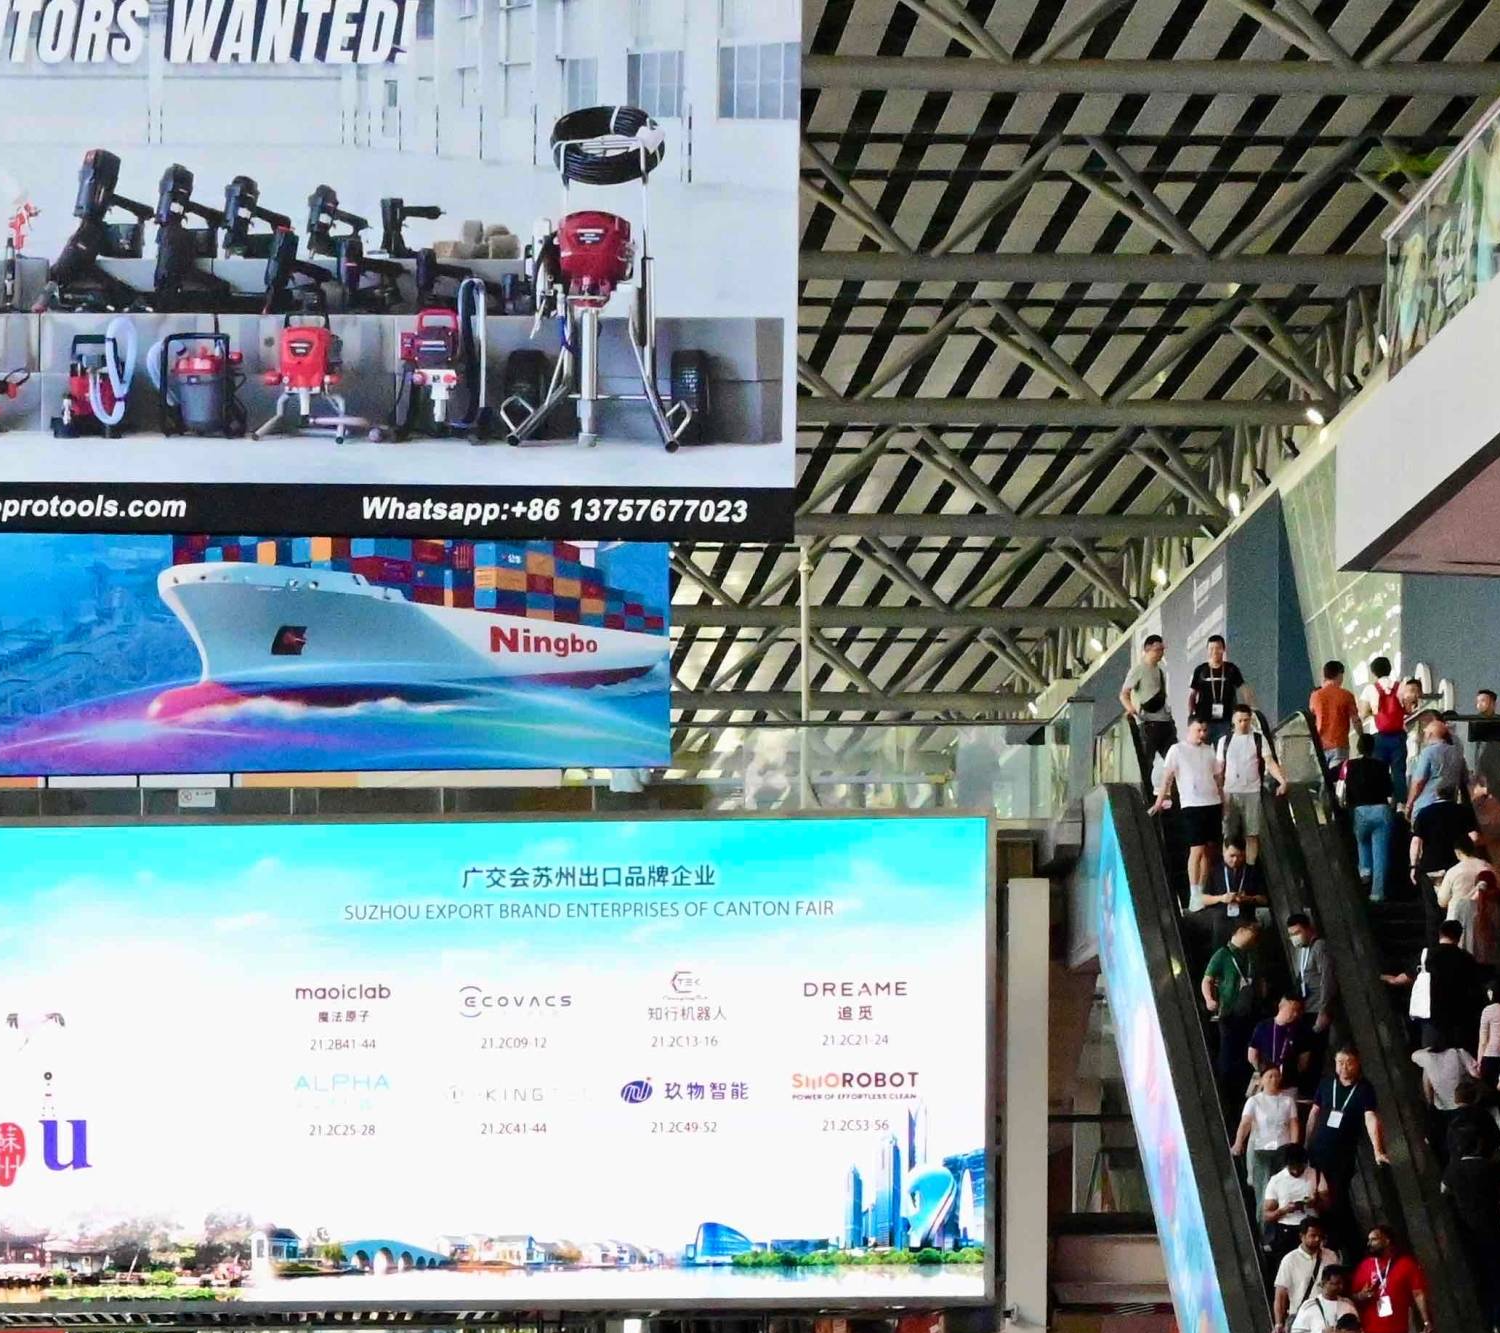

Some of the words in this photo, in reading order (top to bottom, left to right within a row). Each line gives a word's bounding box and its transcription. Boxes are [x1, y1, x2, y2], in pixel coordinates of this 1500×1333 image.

[361, 495, 560, 528] Whatsapp:+86
[569, 498, 748, 525] 13757677023
[489, 625, 599, 660] Ningbo
[463, 865, 716, 889] 广交会苏州出口品牌企业
[344, 903, 421, 922] SUZHOU
[426, 903, 495, 921] EXPORT
[500, 902, 561, 920] BRAND
[566, 901, 680, 919] ENTERPRISES
[684, 901, 709, 918] OF
[713, 900, 790, 917] CANTON
[795, 899, 834, 917] FAIR
[464, 995, 573, 1008] ECOVACS
[803, 981, 908, 997] DREAME
[318, 1009, 370, 1024] 魔法原子
[647, 1004, 728, 1022] 知行机器人
[837, 1005, 874, 1021] 追觅
[480, 1036, 548, 1050] 21.2C09-12
[650, 1035, 719, 1048] 21.2C13-16
[822, 1033, 889, 1047] 21.2C21-24
[293, 1073, 391, 1092] ALPHA
[664, 1080, 749, 1101] 玖物智能
